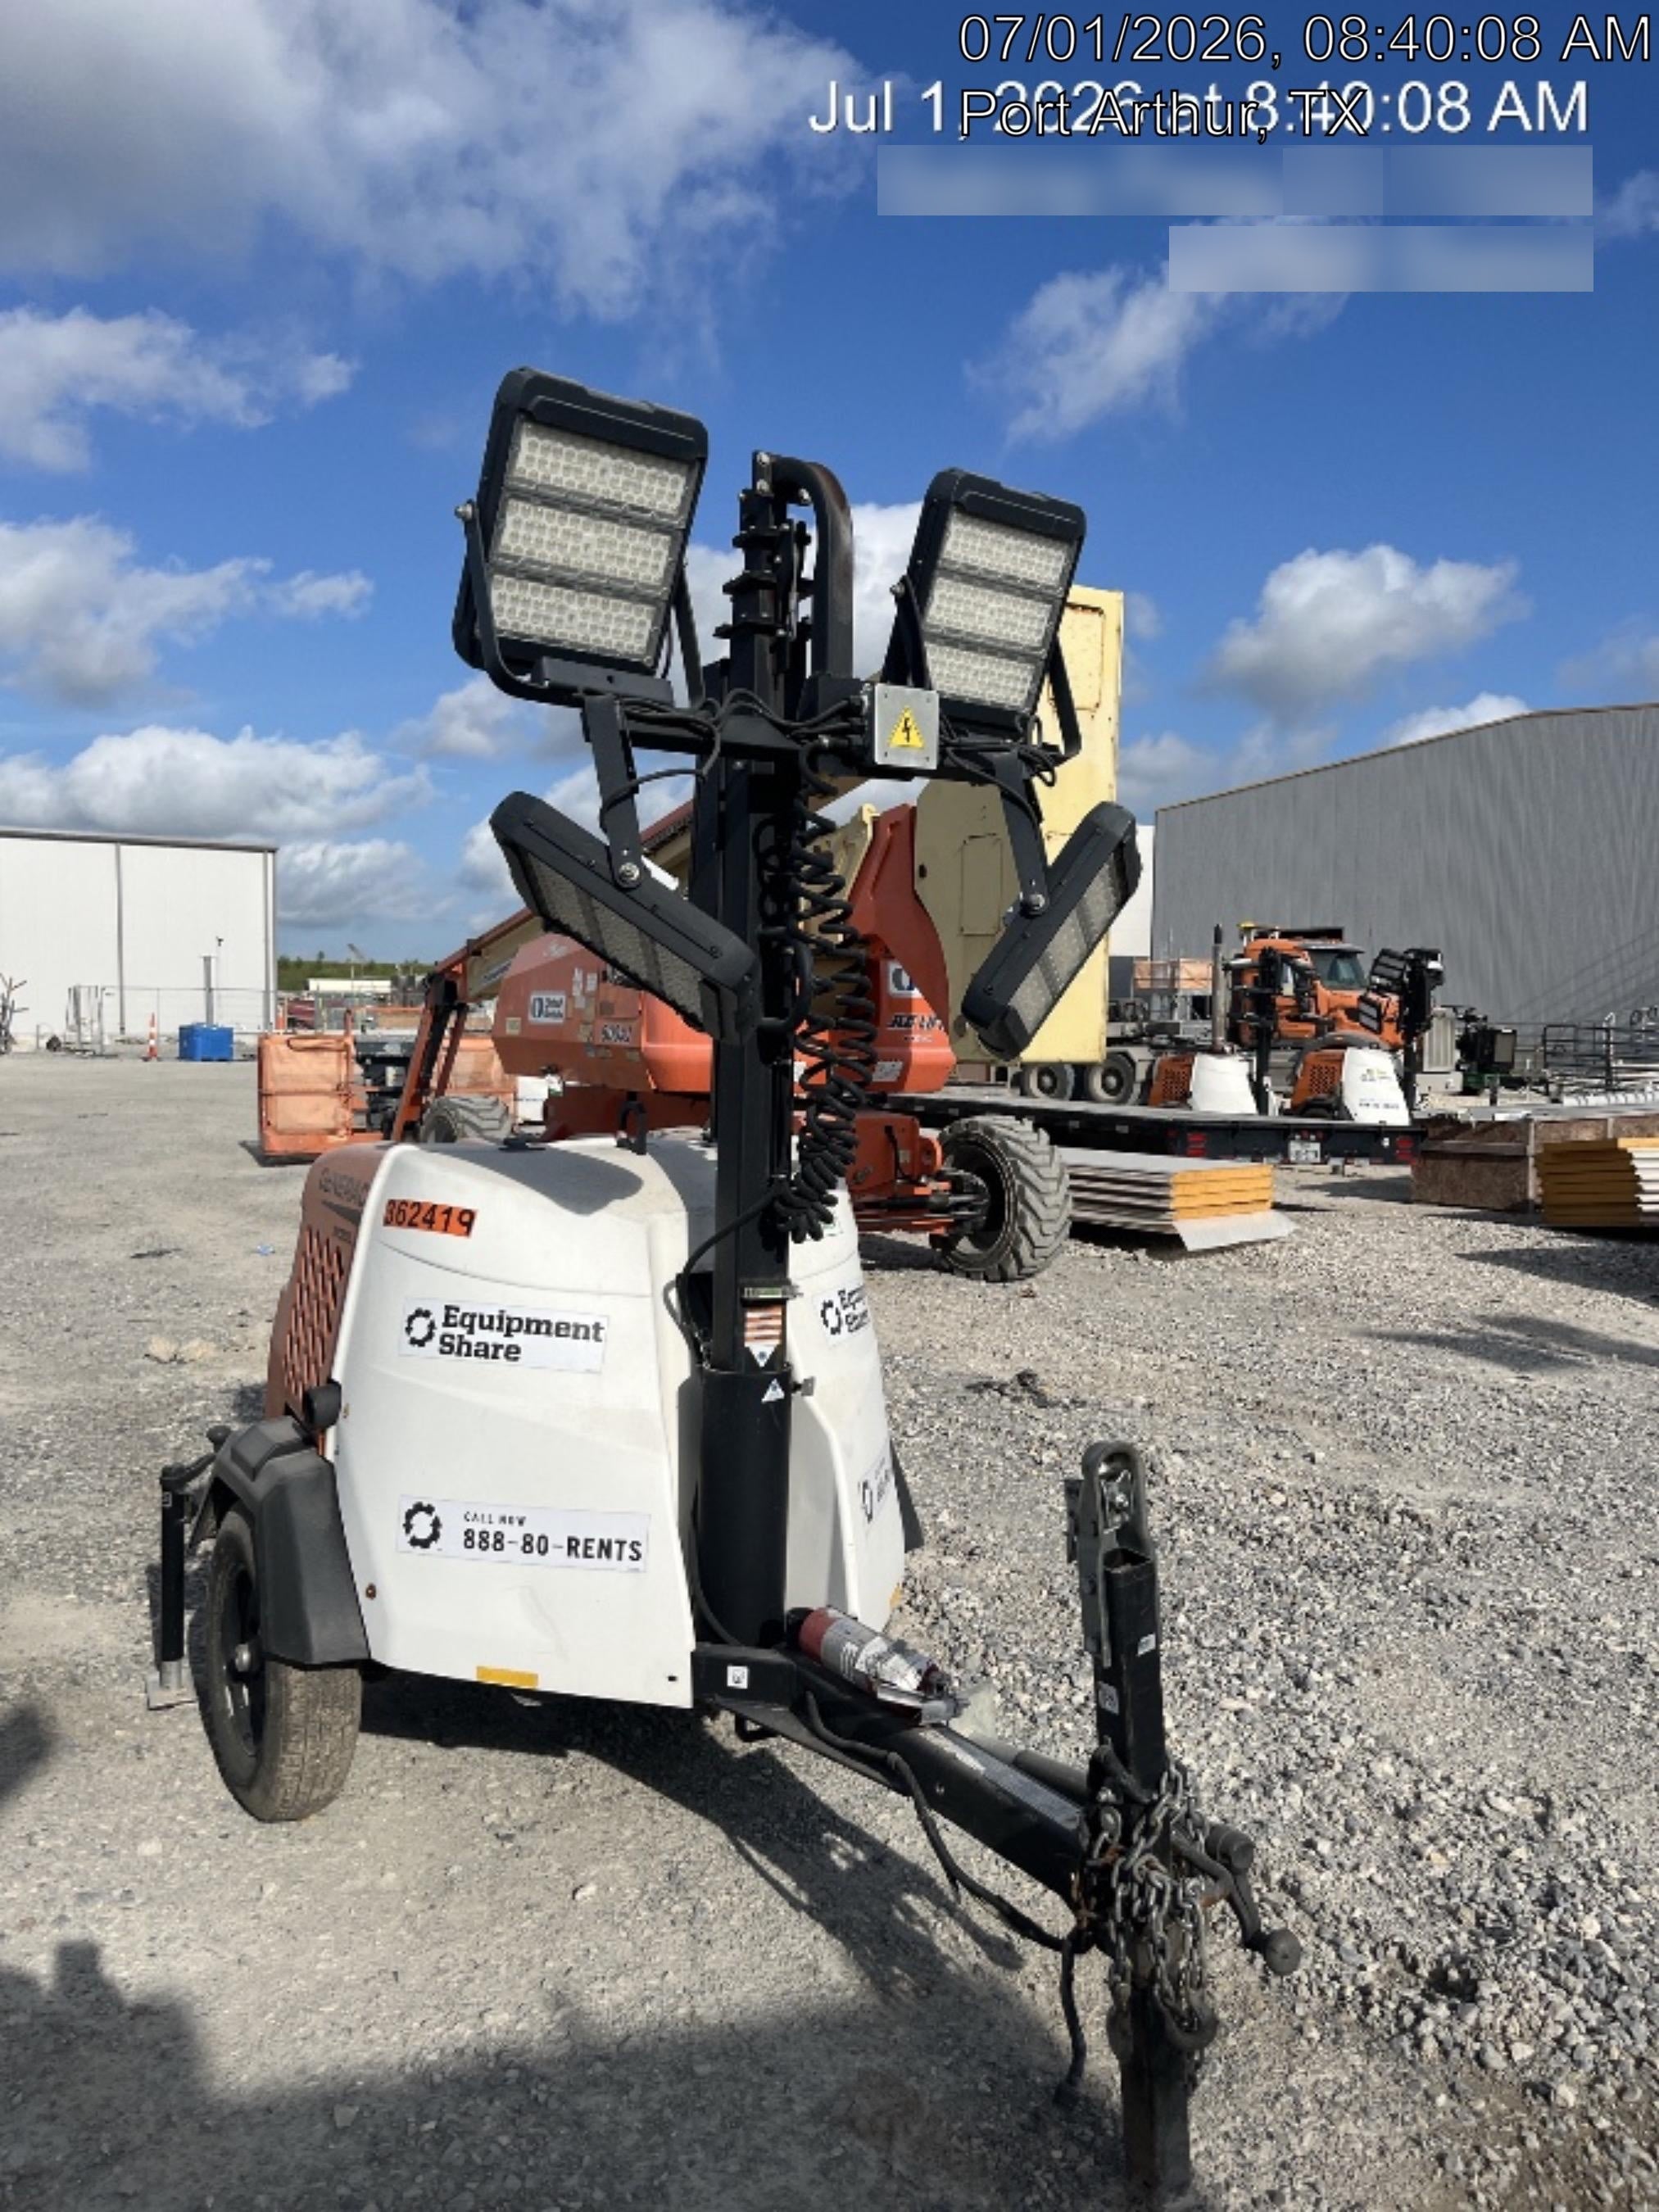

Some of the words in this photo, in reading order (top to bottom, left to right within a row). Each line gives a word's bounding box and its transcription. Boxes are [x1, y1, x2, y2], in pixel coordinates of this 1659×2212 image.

[442, 1304, 605, 1343] Equipment
[438, 1334, 522, 1362] Share
[464, 1511, 494, 1525] CALL
[463, 1528, 643, 1562] 888-80-RENTS
